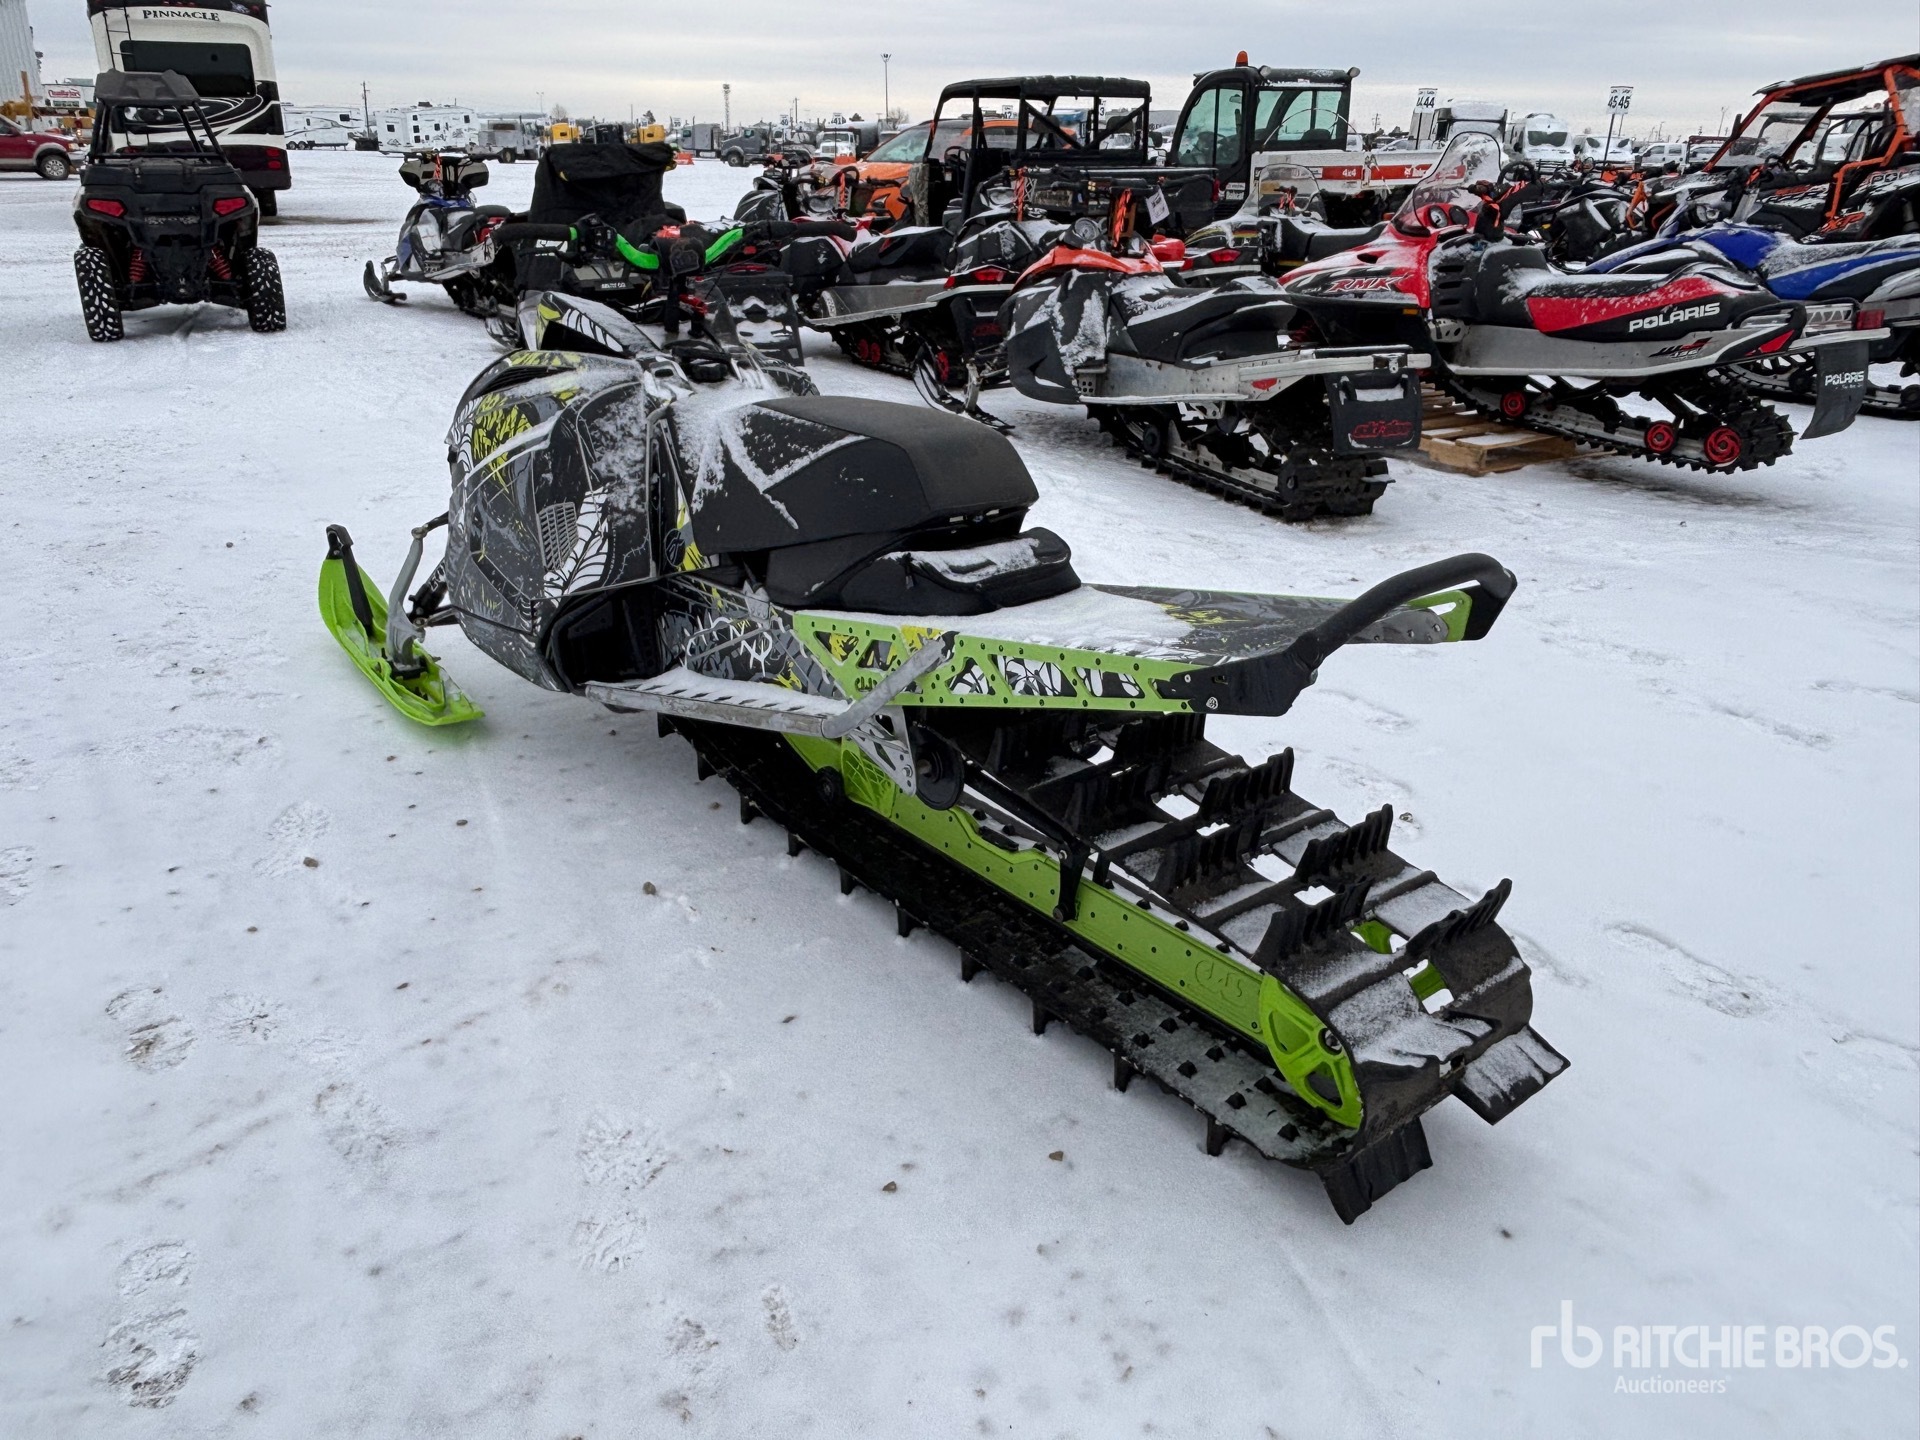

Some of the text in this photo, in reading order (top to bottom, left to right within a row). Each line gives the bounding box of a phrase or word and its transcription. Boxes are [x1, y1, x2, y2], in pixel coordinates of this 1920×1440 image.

[142, 9, 220, 22] PINNACLE
[1423, 96, 1435, 108] 44
[1618, 95, 1631, 109] 45
[1342, 168, 1357, 177] 4x4
[1323, 276, 1405, 294] RMK
[1628, 302, 1721, 333] POLARIS
[1824, 370, 1865, 386] POLARIS
